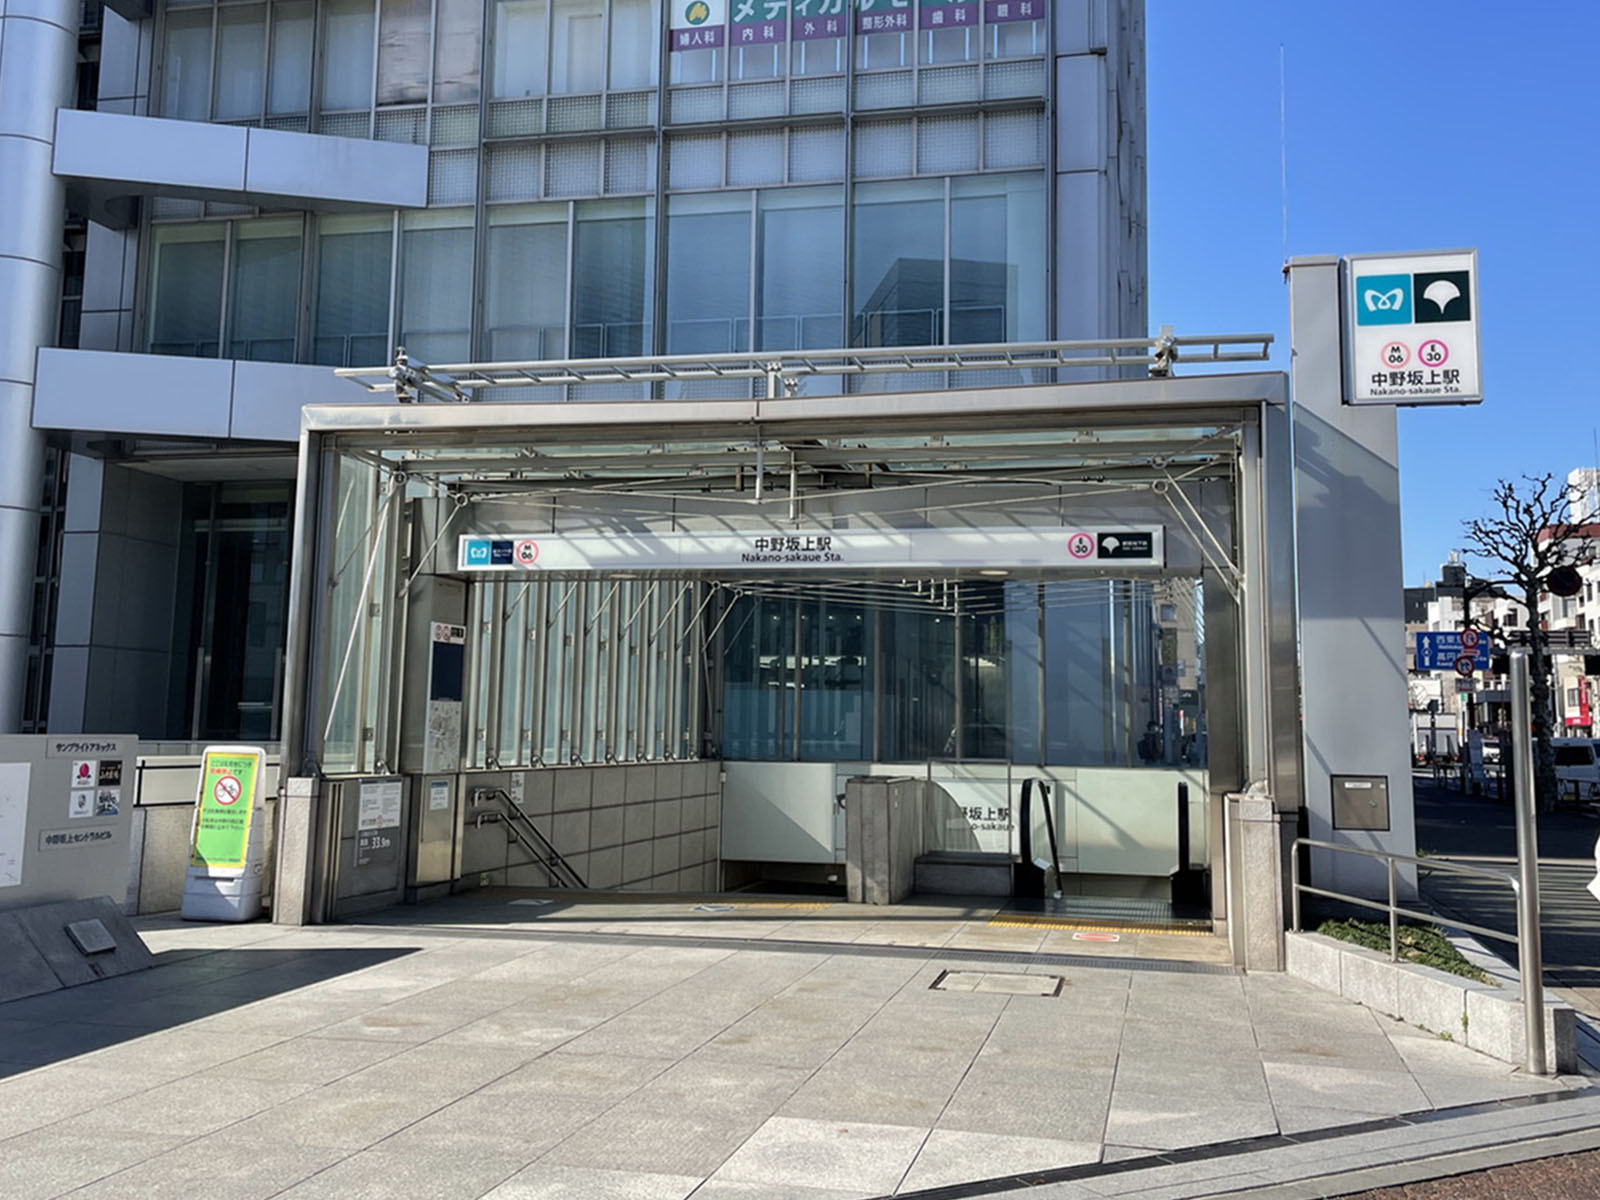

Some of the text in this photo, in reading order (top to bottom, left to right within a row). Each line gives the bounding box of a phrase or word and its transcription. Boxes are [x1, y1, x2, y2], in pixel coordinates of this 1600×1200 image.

[679, 32, 715, 46] 婦人科
[862, 13, 907, 30] 整形外科
[1390, 346, 1401, 354] M
[1430, 344, 1436, 352] E
[1388, 354, 1404, 363] 06
[1426, 353, 1441, 361] 30
[1371, 369, 1460, 386] 中野坂上駅
[1370, 384, 1462, 396] Nakano-sakaue Sta.
[755, 536, 832, 552] 中野坂上駅
[1075, 545, 1088, 553] 30
[741, 552, 845, 562] Nakano-sakaue Sta.
